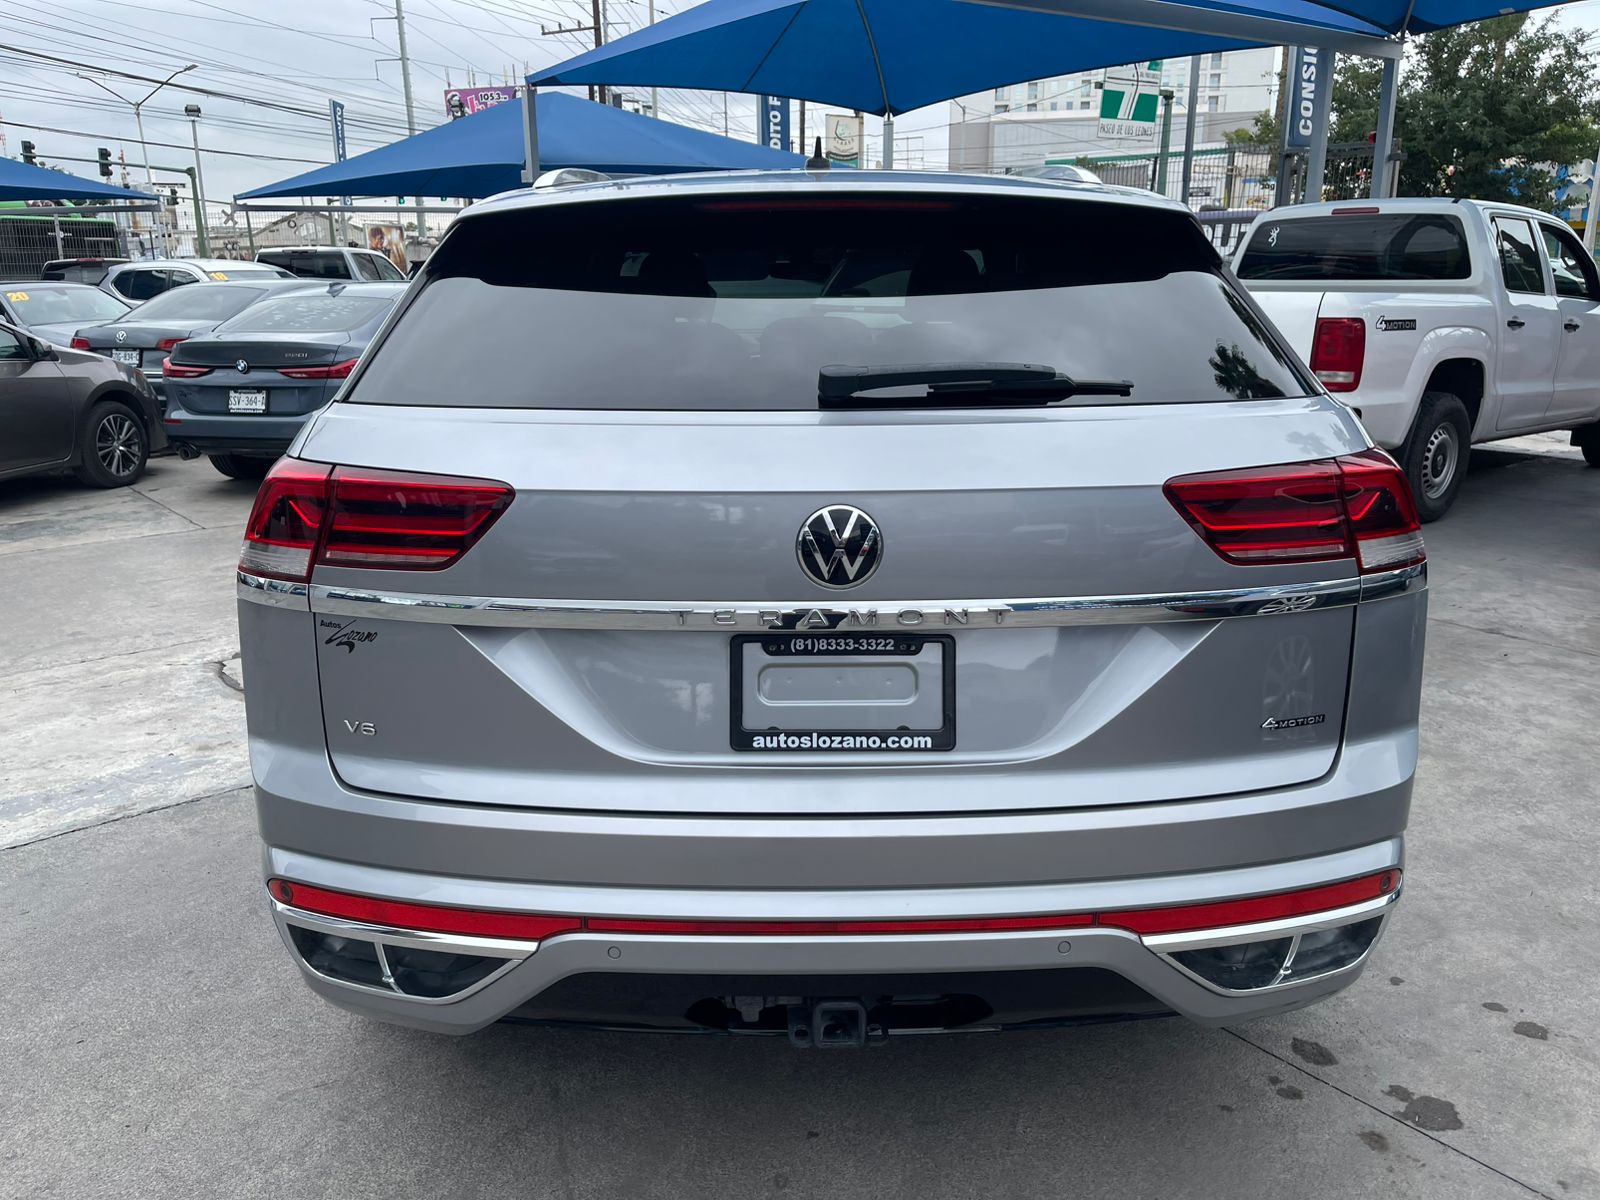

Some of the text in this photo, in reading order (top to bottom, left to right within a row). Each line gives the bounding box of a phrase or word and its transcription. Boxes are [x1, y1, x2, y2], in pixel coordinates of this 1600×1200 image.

[1100, 123, 1153, 137] PASEO DE LOS LEONES
[320, 619, 342, 629] Autos
[669, 607, 1013, 627] TERAMONT
[790, 638, 895, 653] (81)8333-3322
[344, 719, 377, 735] V6
[752, 733, 932, 749] autoslozano.com
